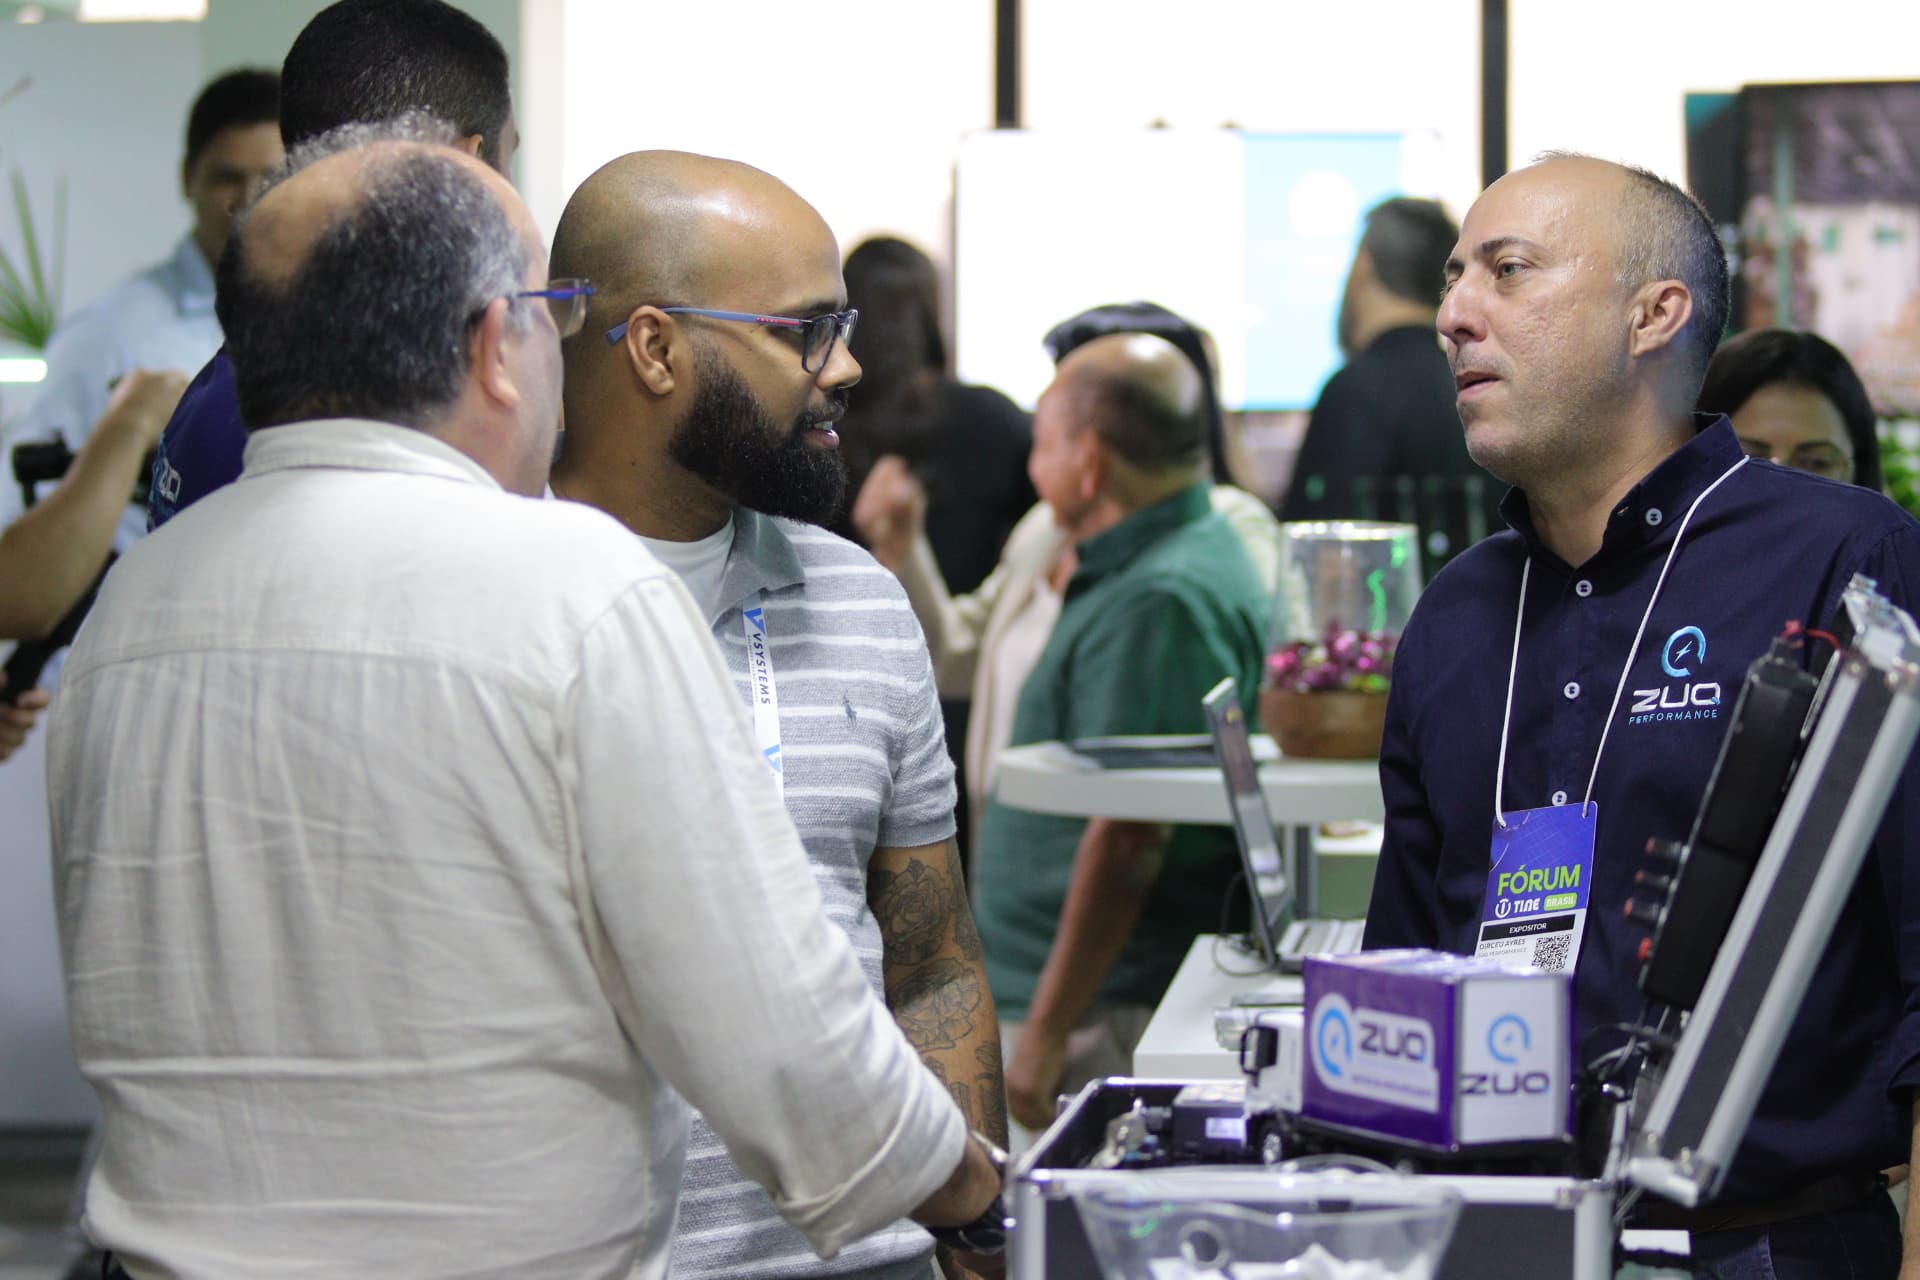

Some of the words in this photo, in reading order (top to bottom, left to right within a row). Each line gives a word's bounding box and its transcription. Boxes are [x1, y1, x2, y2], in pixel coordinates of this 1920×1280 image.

[752, 633, 771, 704] VSYSTEMS
[1629, 709, 1718, 725] PERFORMANCE
[1497, 864, 1581, 896] FÓRUM
[1546, 896, 1574, 908] BRASIL
[1509, 923, 1547, 934] EXPOSITOR
[1479, 941, 1504, 950] DIRCEU
[1504, 938, 1526, 947] AYRES
